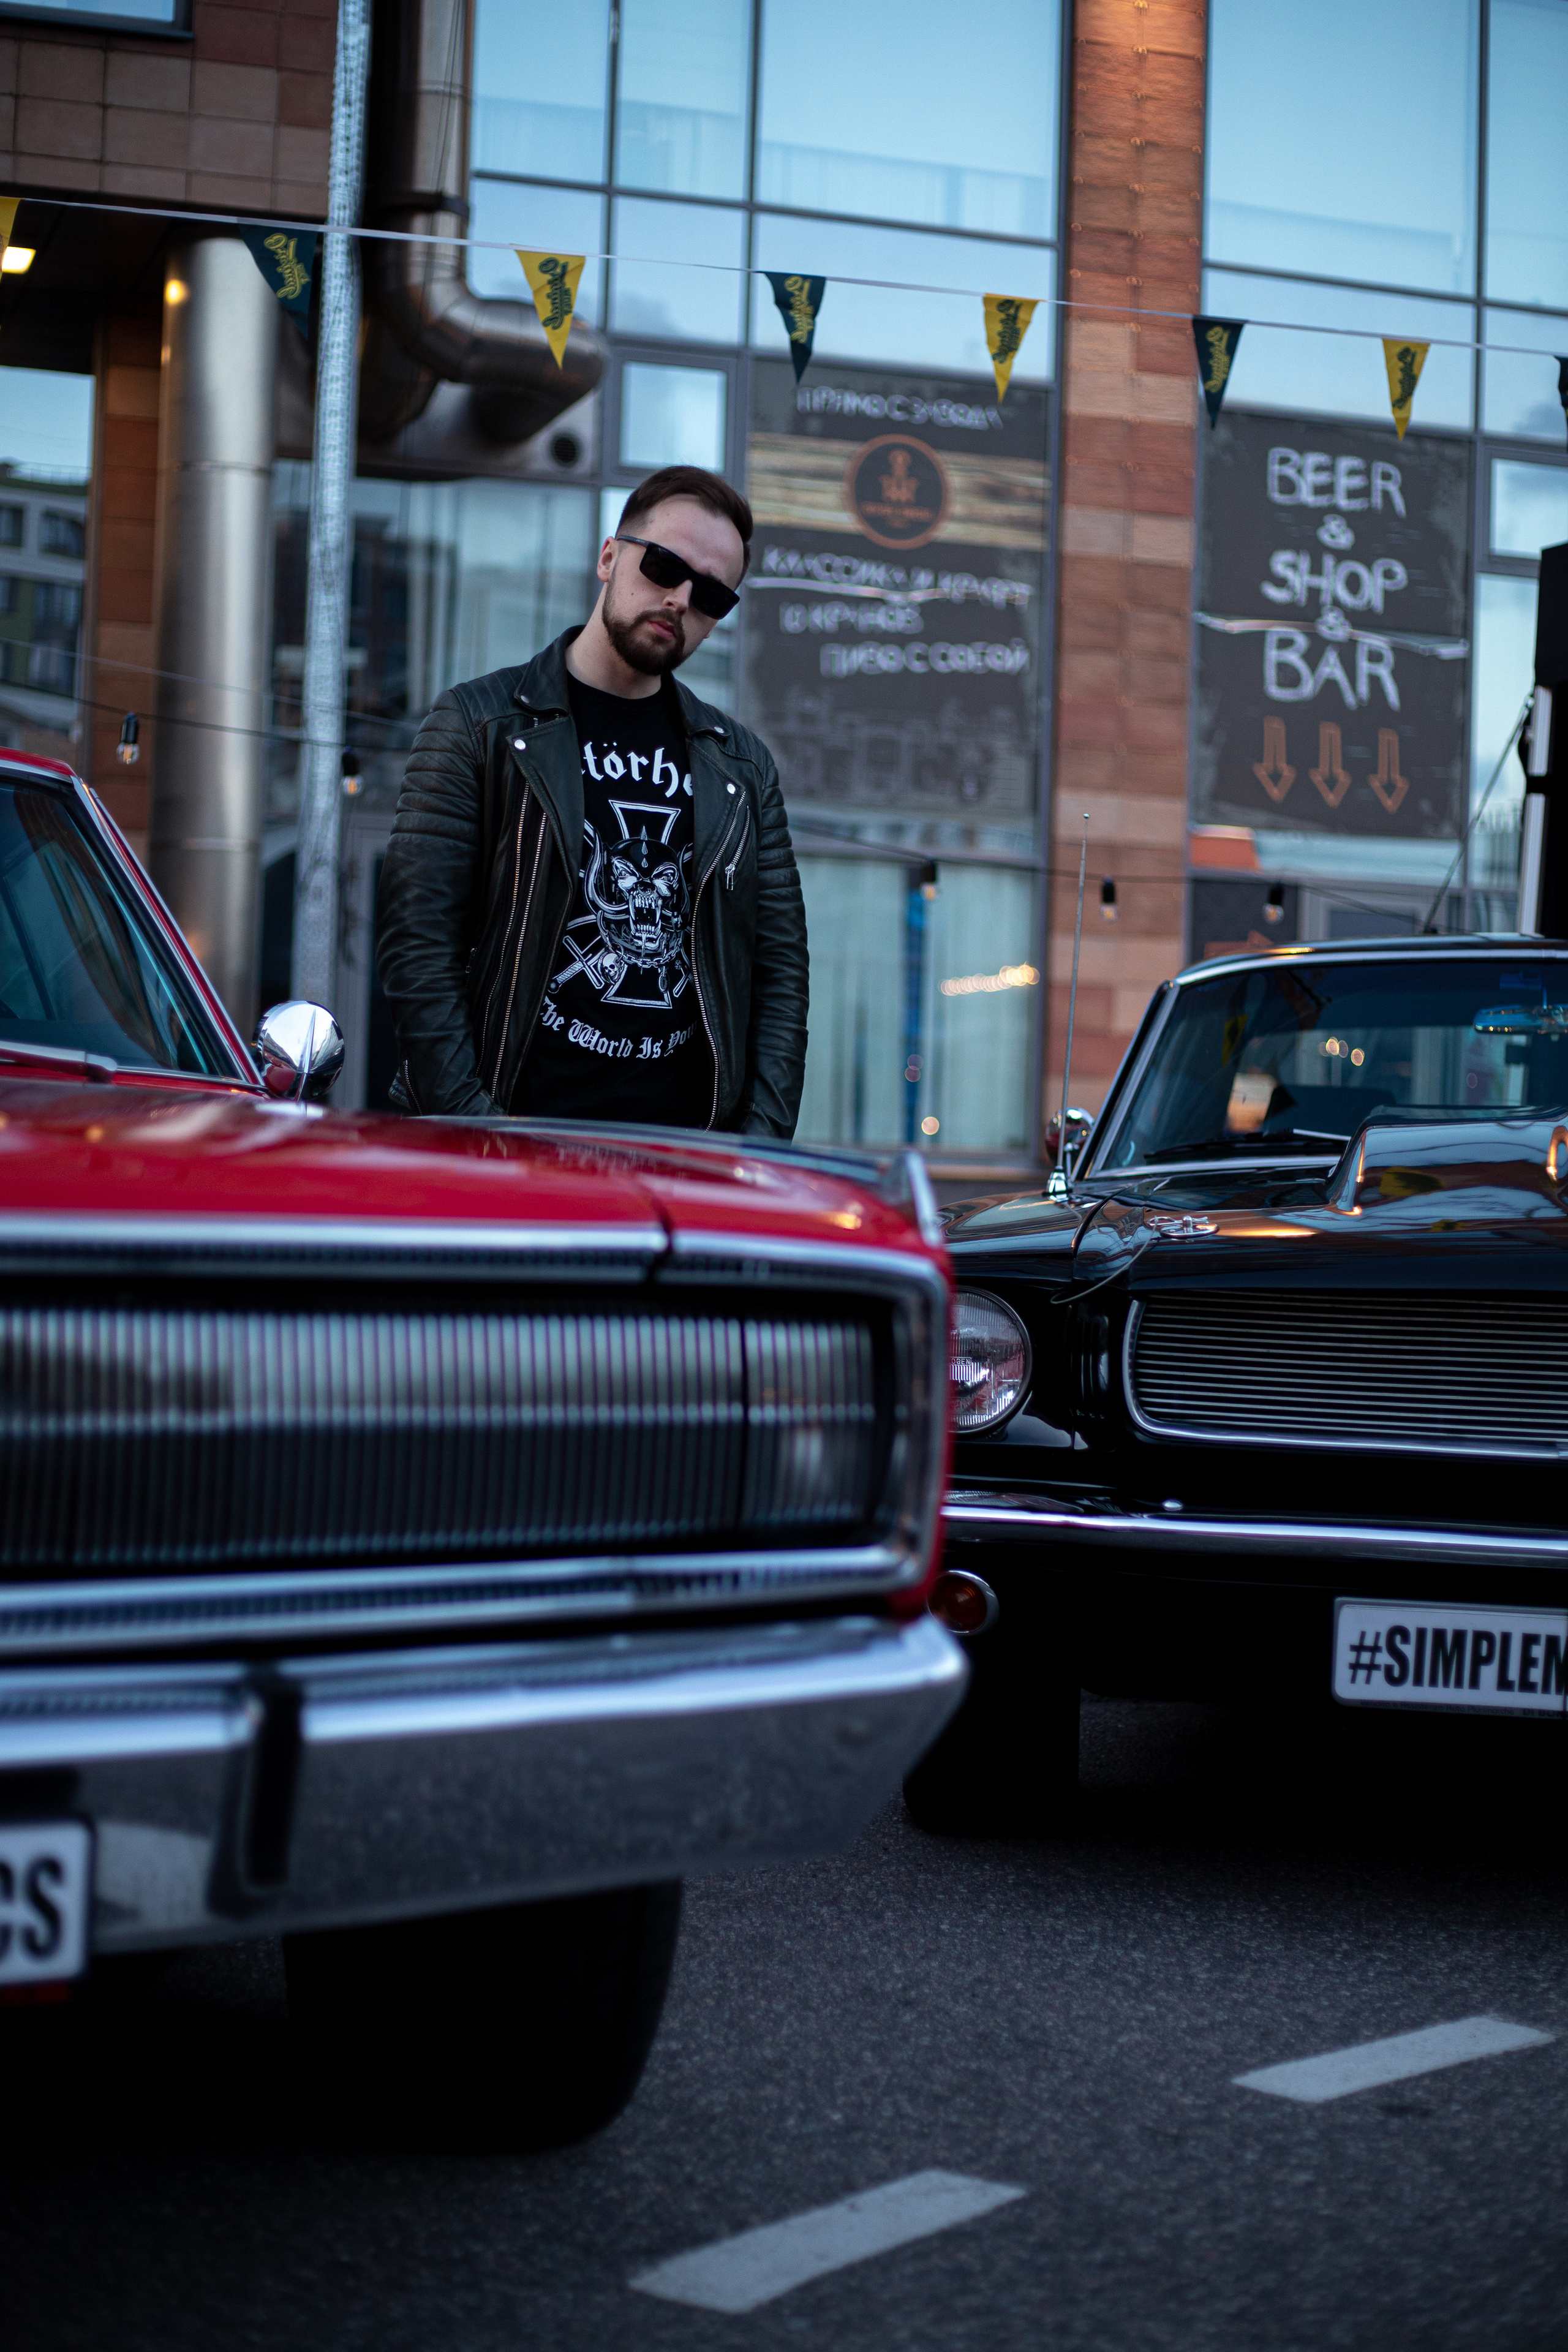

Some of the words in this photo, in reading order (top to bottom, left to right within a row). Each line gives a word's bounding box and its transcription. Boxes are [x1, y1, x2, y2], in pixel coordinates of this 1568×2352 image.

[1267, 447, 1407, 518] BEER
[1316, 514, 1355, 549] &
[1260, 549, 1408, 613] SHOP
[1314, 605, 1351, 642] &
[1262, 628, 1401, 711] BAR
[582, 741, 693, 798] törh
[568, 1019, 633, 1058] World
[636, 1036, 663, 1060] Is
[1349, 1624, 1568, 1696] #SIMPLEM
